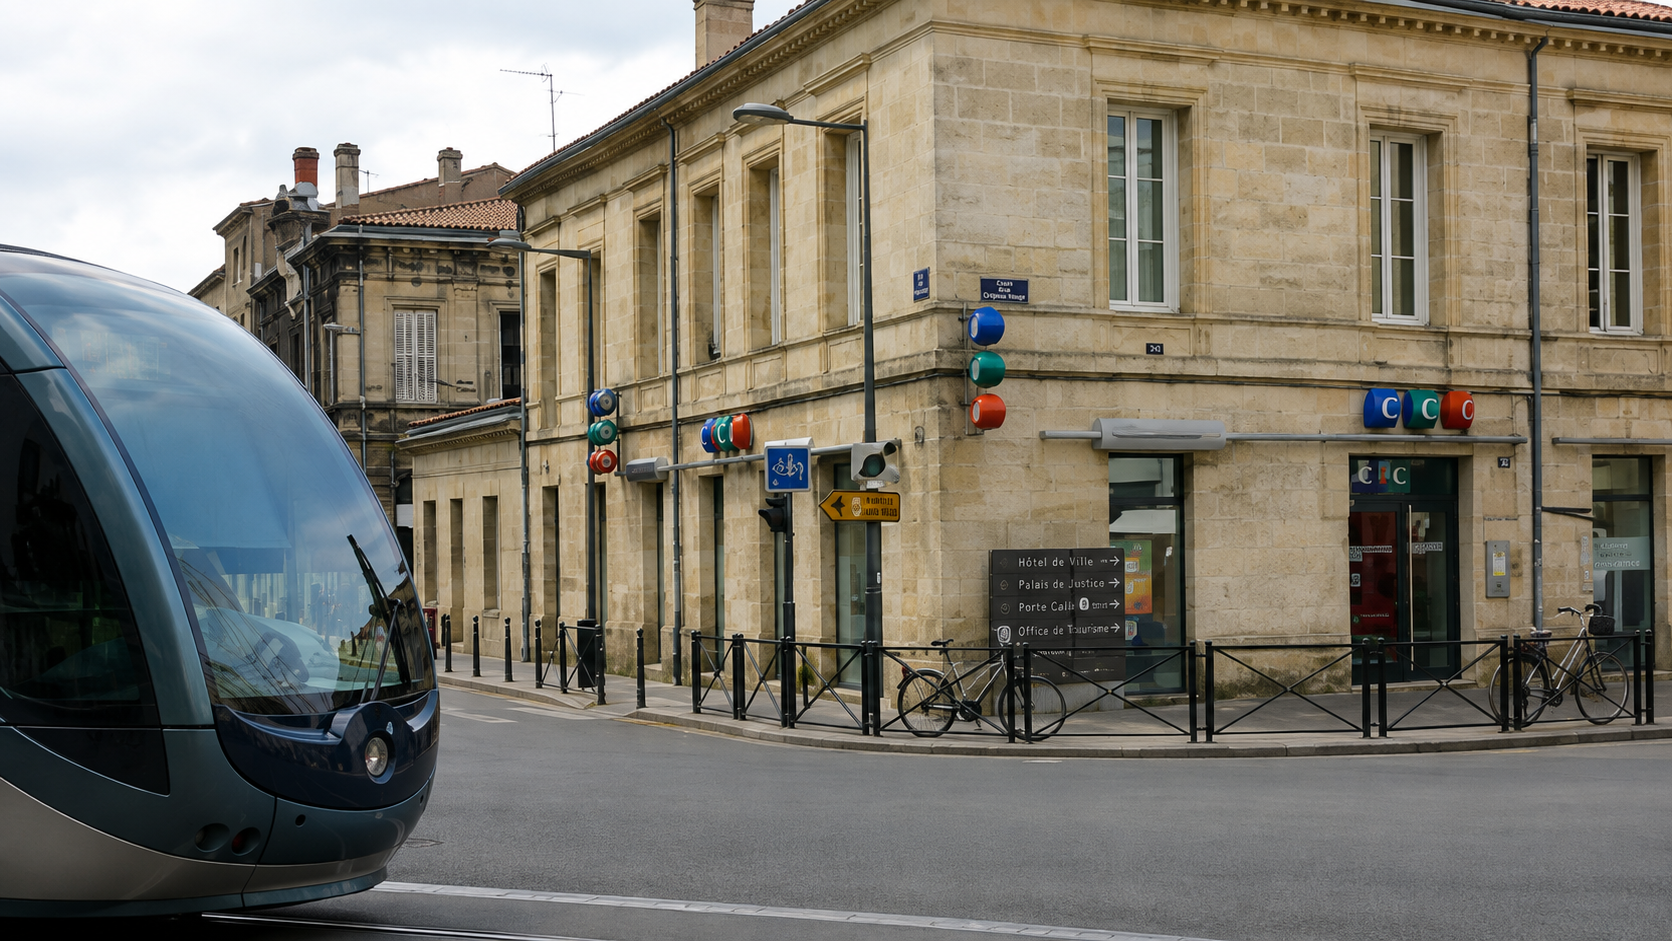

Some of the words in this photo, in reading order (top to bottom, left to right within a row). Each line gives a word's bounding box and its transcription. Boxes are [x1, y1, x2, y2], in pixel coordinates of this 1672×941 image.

[1018, 556, 1047, 568] Hôtel
[1052, 556, 1065, 567] de
[1069, 556, 1094, 567] Ville
[1018, 579, 1049, 590] Palais
[1053, 579, 1065, 589] de
[1068, 578, 1105, 589] Justice
[1018, 602, 1047, 612] Porte
[1018, 626, 1049, 637] Office
[1053, 625, 1064, 635] de
